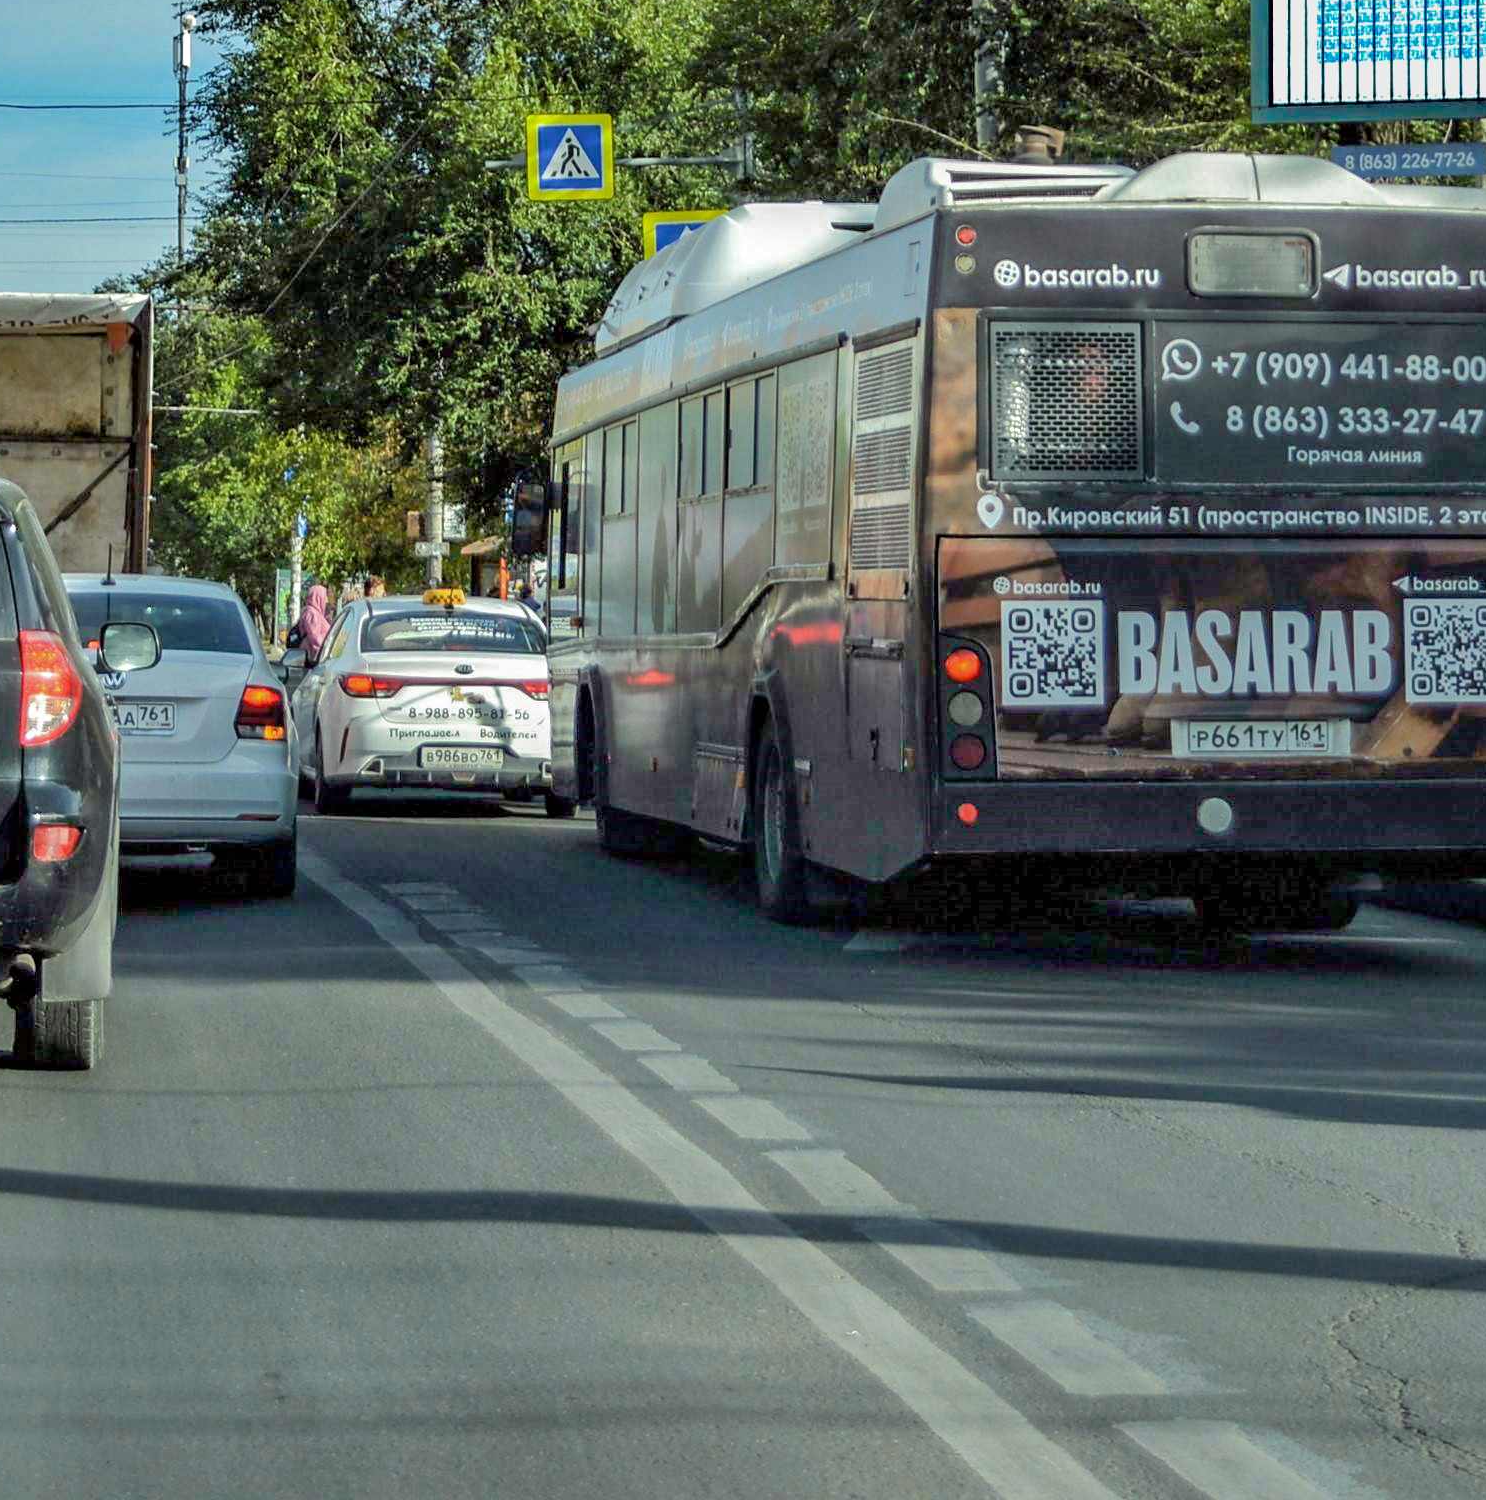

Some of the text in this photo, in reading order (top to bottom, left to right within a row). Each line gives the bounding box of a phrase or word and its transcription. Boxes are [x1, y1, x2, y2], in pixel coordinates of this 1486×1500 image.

[1345, 152, 1475, 171] 8 (863) 226-77-26
[1024, 264, 1160, 286] basarab.ru
[1212, 352, 1486, 386] +7 (909) 441-88-00
[1226, 405, 1484, 438] 8 (863) 333-27-47
[1287, 446, 1422, 465] Горячая линия
[1013, 506, 1162, 528] Пр.Кировский
[1168, 507, 1190, 525] 51
[1198, 507, 1359, 529] (пространство
[1365, 507, 1433, 526] INSIDE,
[1440, 507, 1452, 525] 2
[1013, 579, 1101, 595] basarab.ru
[1117, 610, 1392, 693] BASARAB
